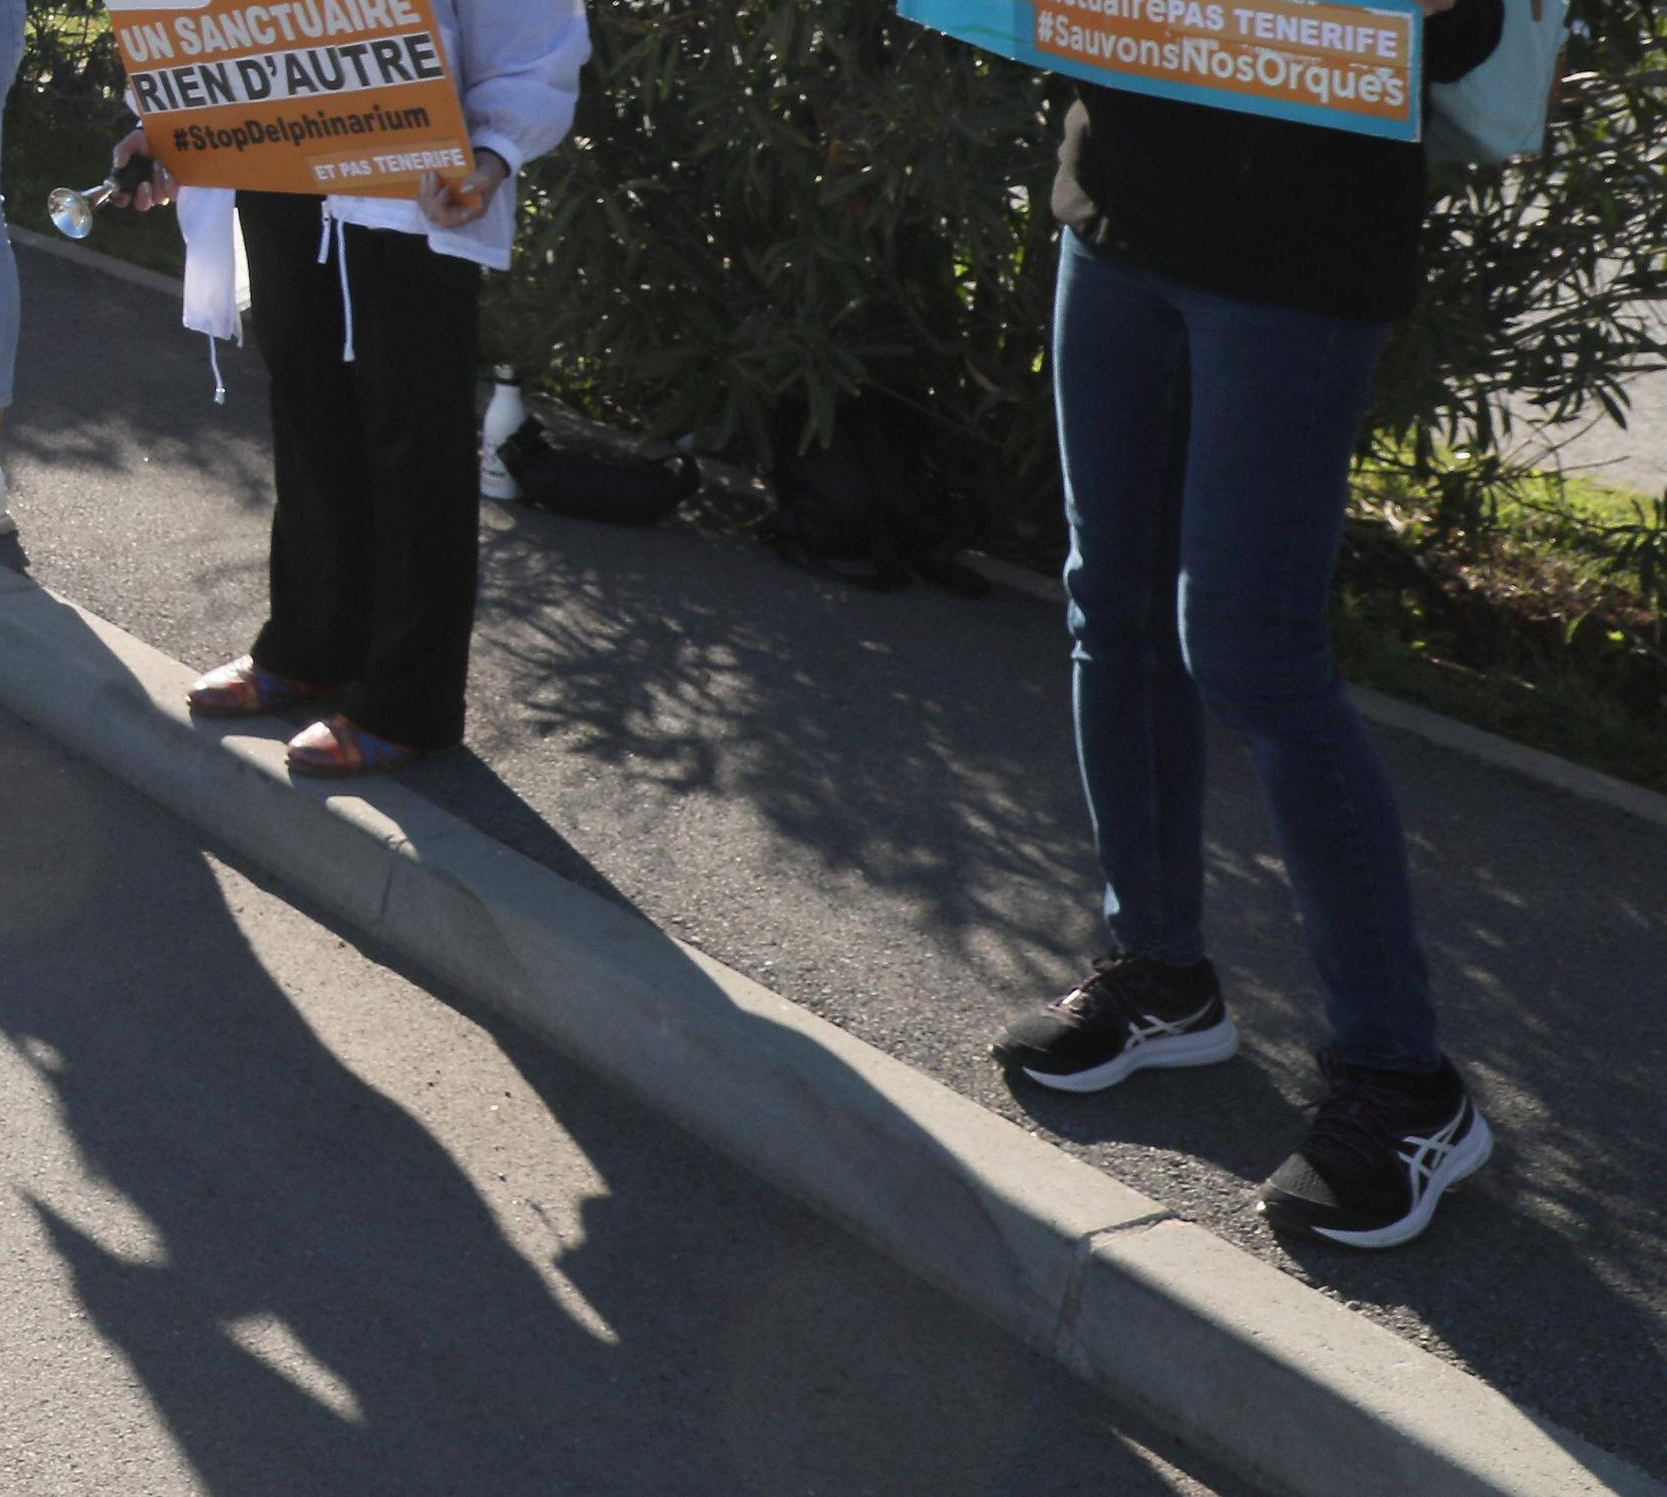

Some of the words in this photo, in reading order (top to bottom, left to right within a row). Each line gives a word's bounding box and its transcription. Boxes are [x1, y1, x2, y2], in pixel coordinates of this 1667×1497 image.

[120, 19, 175, 62] UN
[1233, 8, 1398, 59] TENERIFE
[132, 61, 235, 112] RIEN
[236, 34, 444, 100] D'AUTRE
[1037, 10, 1405, 107] #SauvonsNosOrques
[173, 104, 431, 152] #StopDelphinarium
[314, 163, 337, 180] ET
[340, 158, 372, 178] PAS
[373, 147, 465, 175] TENERIFE
